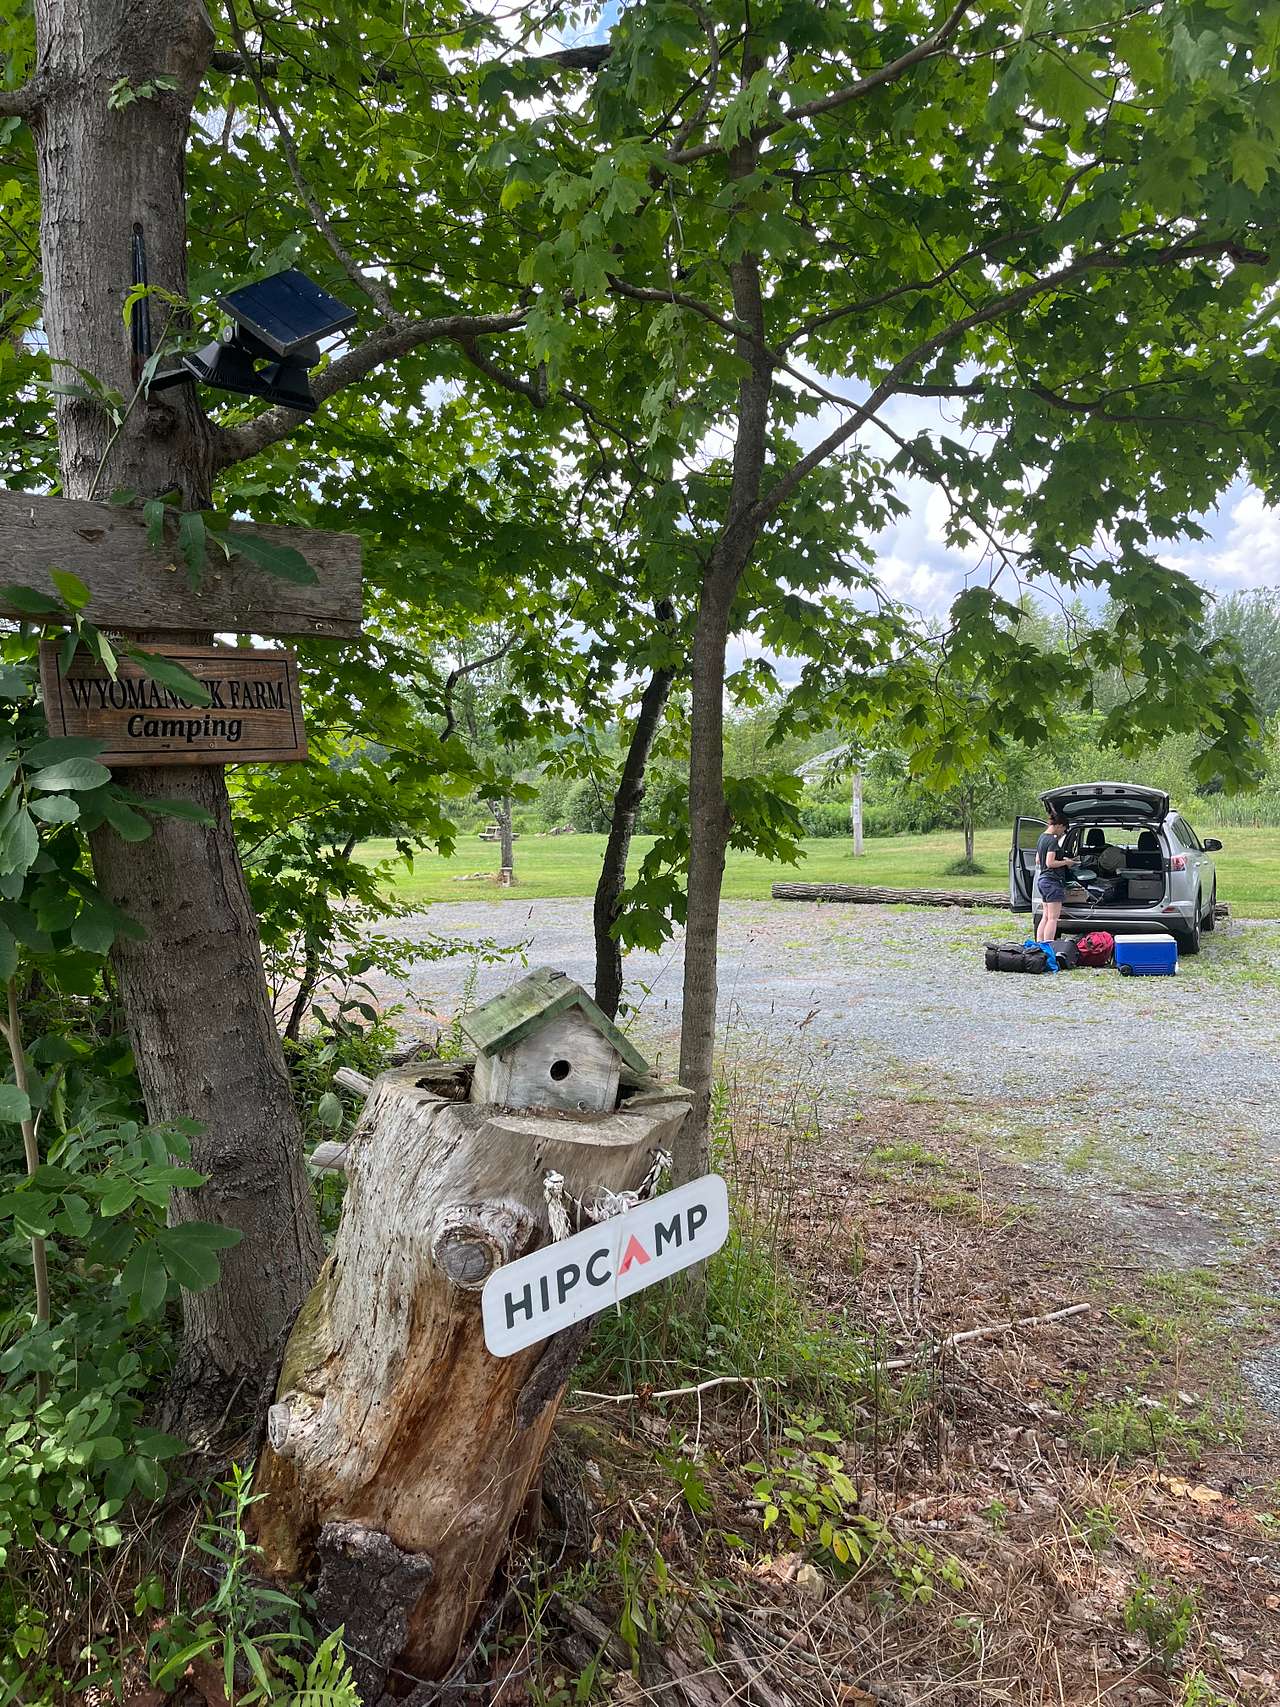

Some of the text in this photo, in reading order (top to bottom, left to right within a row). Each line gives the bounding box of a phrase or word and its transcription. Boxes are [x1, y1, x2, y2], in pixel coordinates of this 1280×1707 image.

[230, 681, 286, 710] FARM
[127, 714, 242, 743] Camping
[504, 1204, 708, 1330] HIPCAMP
